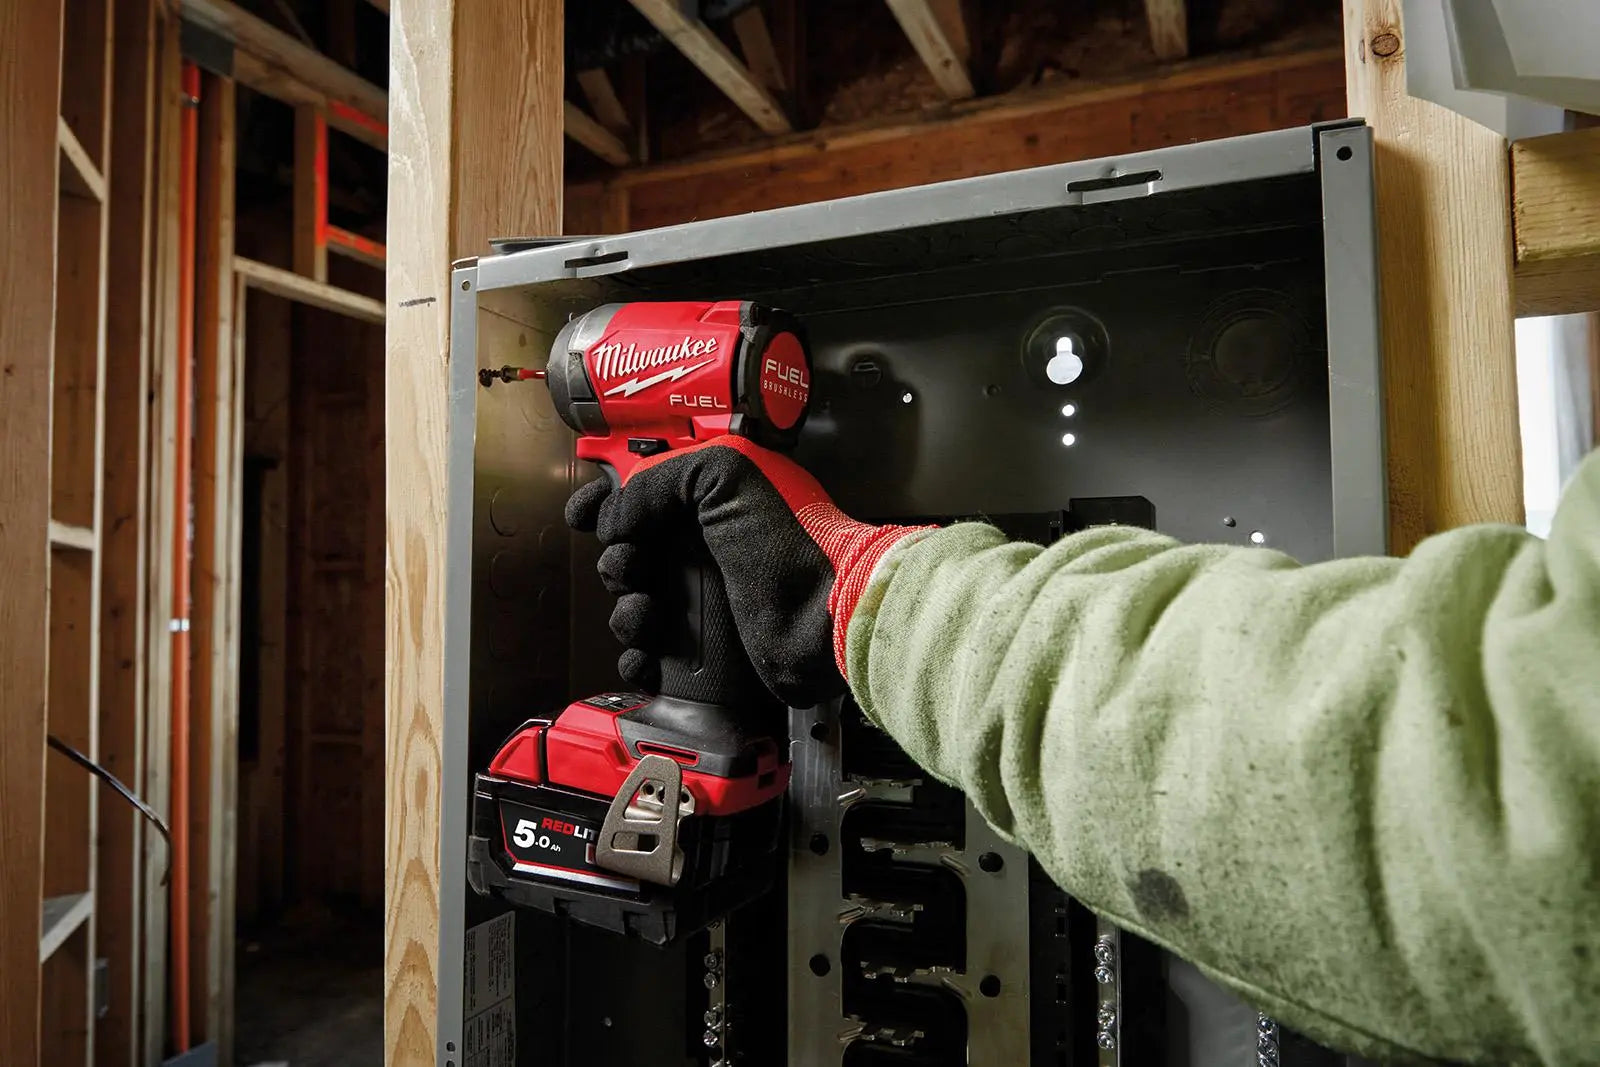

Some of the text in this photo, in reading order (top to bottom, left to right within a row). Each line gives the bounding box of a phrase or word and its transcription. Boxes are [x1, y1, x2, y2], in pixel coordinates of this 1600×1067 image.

[592, 336, 718, 381] Milwaukee
[764, 358, 809, 388] FUEL
[669, 394, 727, 408] FUEL
[763, 379, 809, 403] BRUSHLESS
[512, 818, 561, 853] 5.0 Ah
[541, 817, 599, 841] REDLIT
